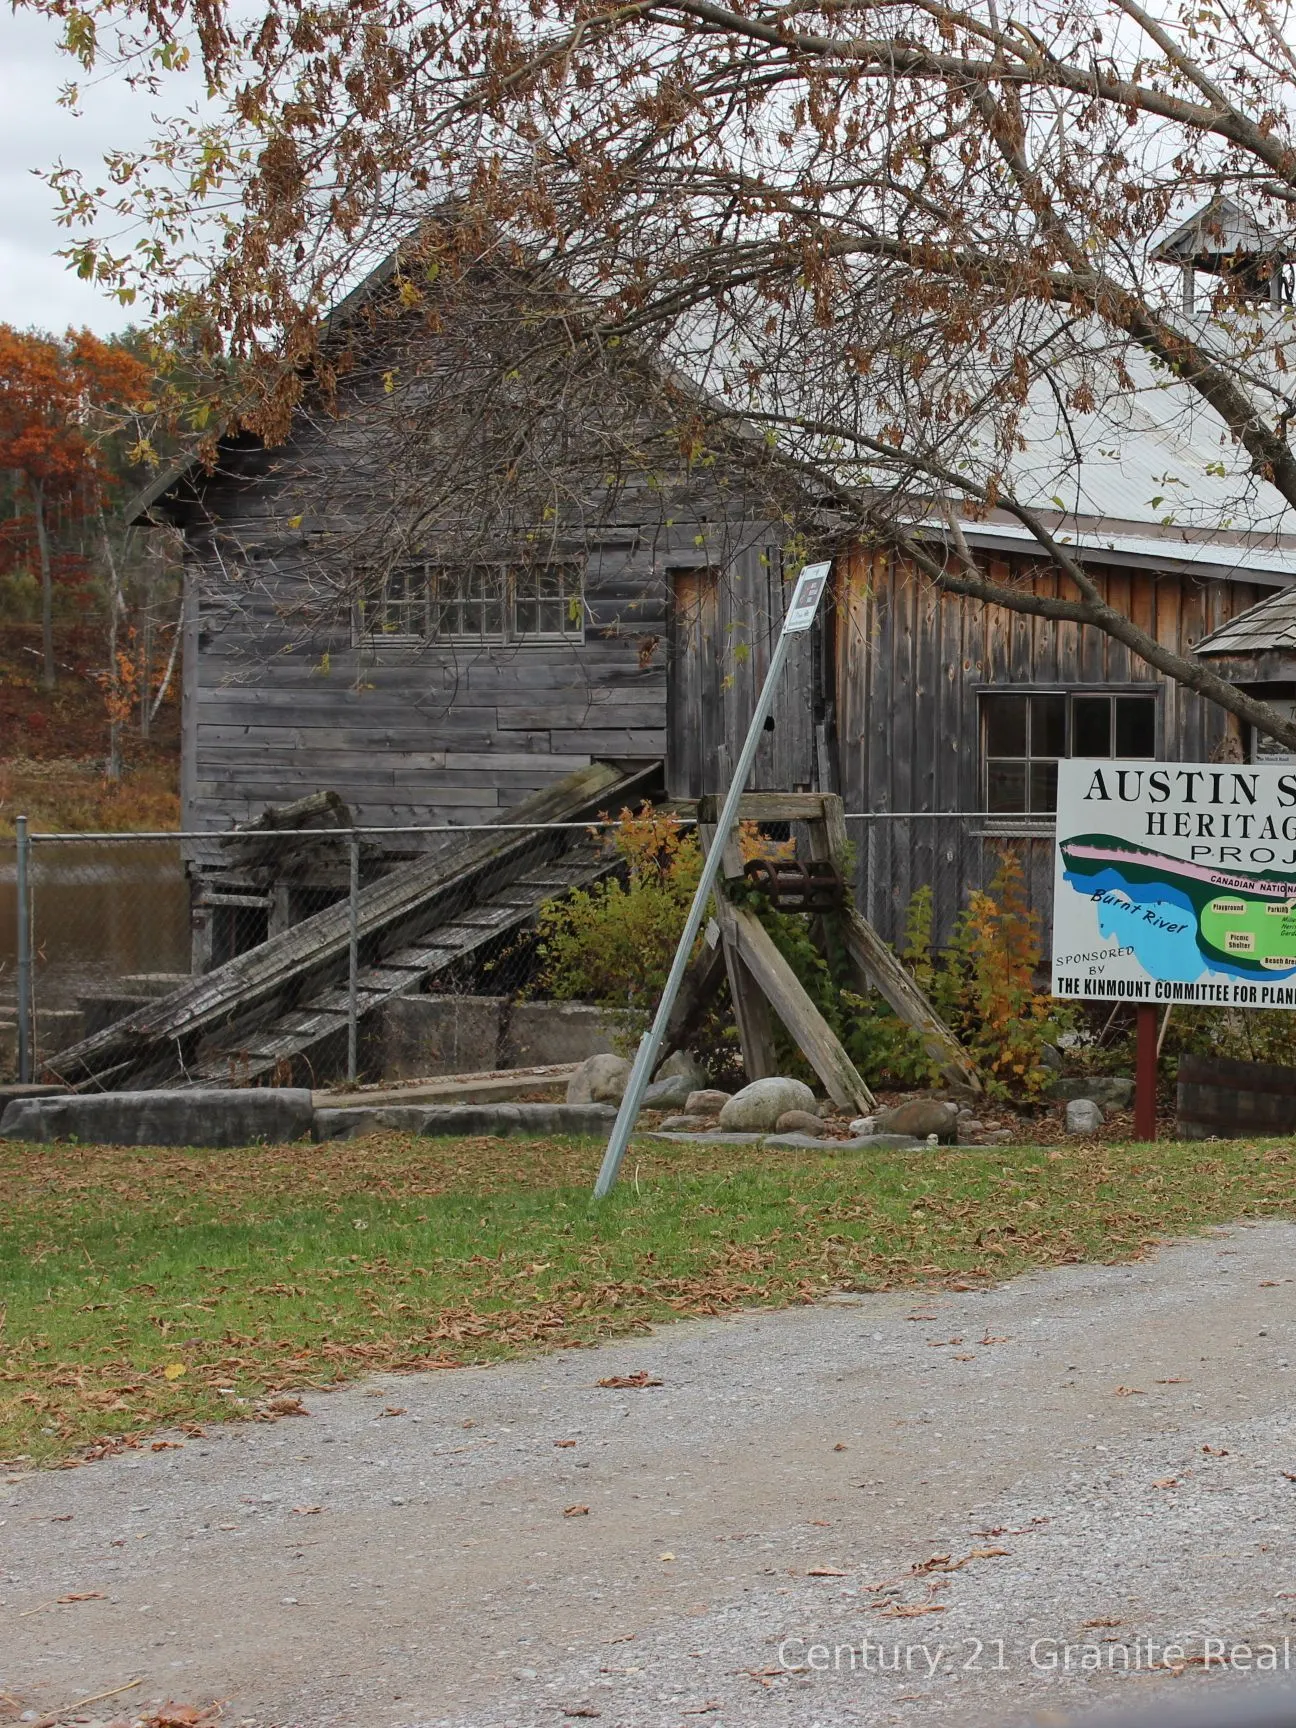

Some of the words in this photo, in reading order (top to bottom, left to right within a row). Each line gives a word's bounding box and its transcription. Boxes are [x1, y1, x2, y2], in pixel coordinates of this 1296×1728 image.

[1083, 768, 1260, 806] AUSTIN
[1210, 875, 1255, 890] CANADIAN
[1090, 888, 1142, 915] Burnt
[1142, 909, 1189, 934] River
[1212, 903, 1244, 912] Playground
[1267, 905, 1289, 914] Parking
[1230, 934, 1250, 942] Picnic
[1228, 941, 1251, 950] Shelter
[1055, 945, 1135, 967] SPONSORED
[1264, 957, 1284, 965] Beach
[1088, 965, 1106, 976] BY
[1057, 977, 1080, 995] THE
[1084, 978, 1151, 998] KINMOUNT
[1154, 980, 1229, 1002] COMMITTEE
[1233, 985, 1257, 1003] FOR
